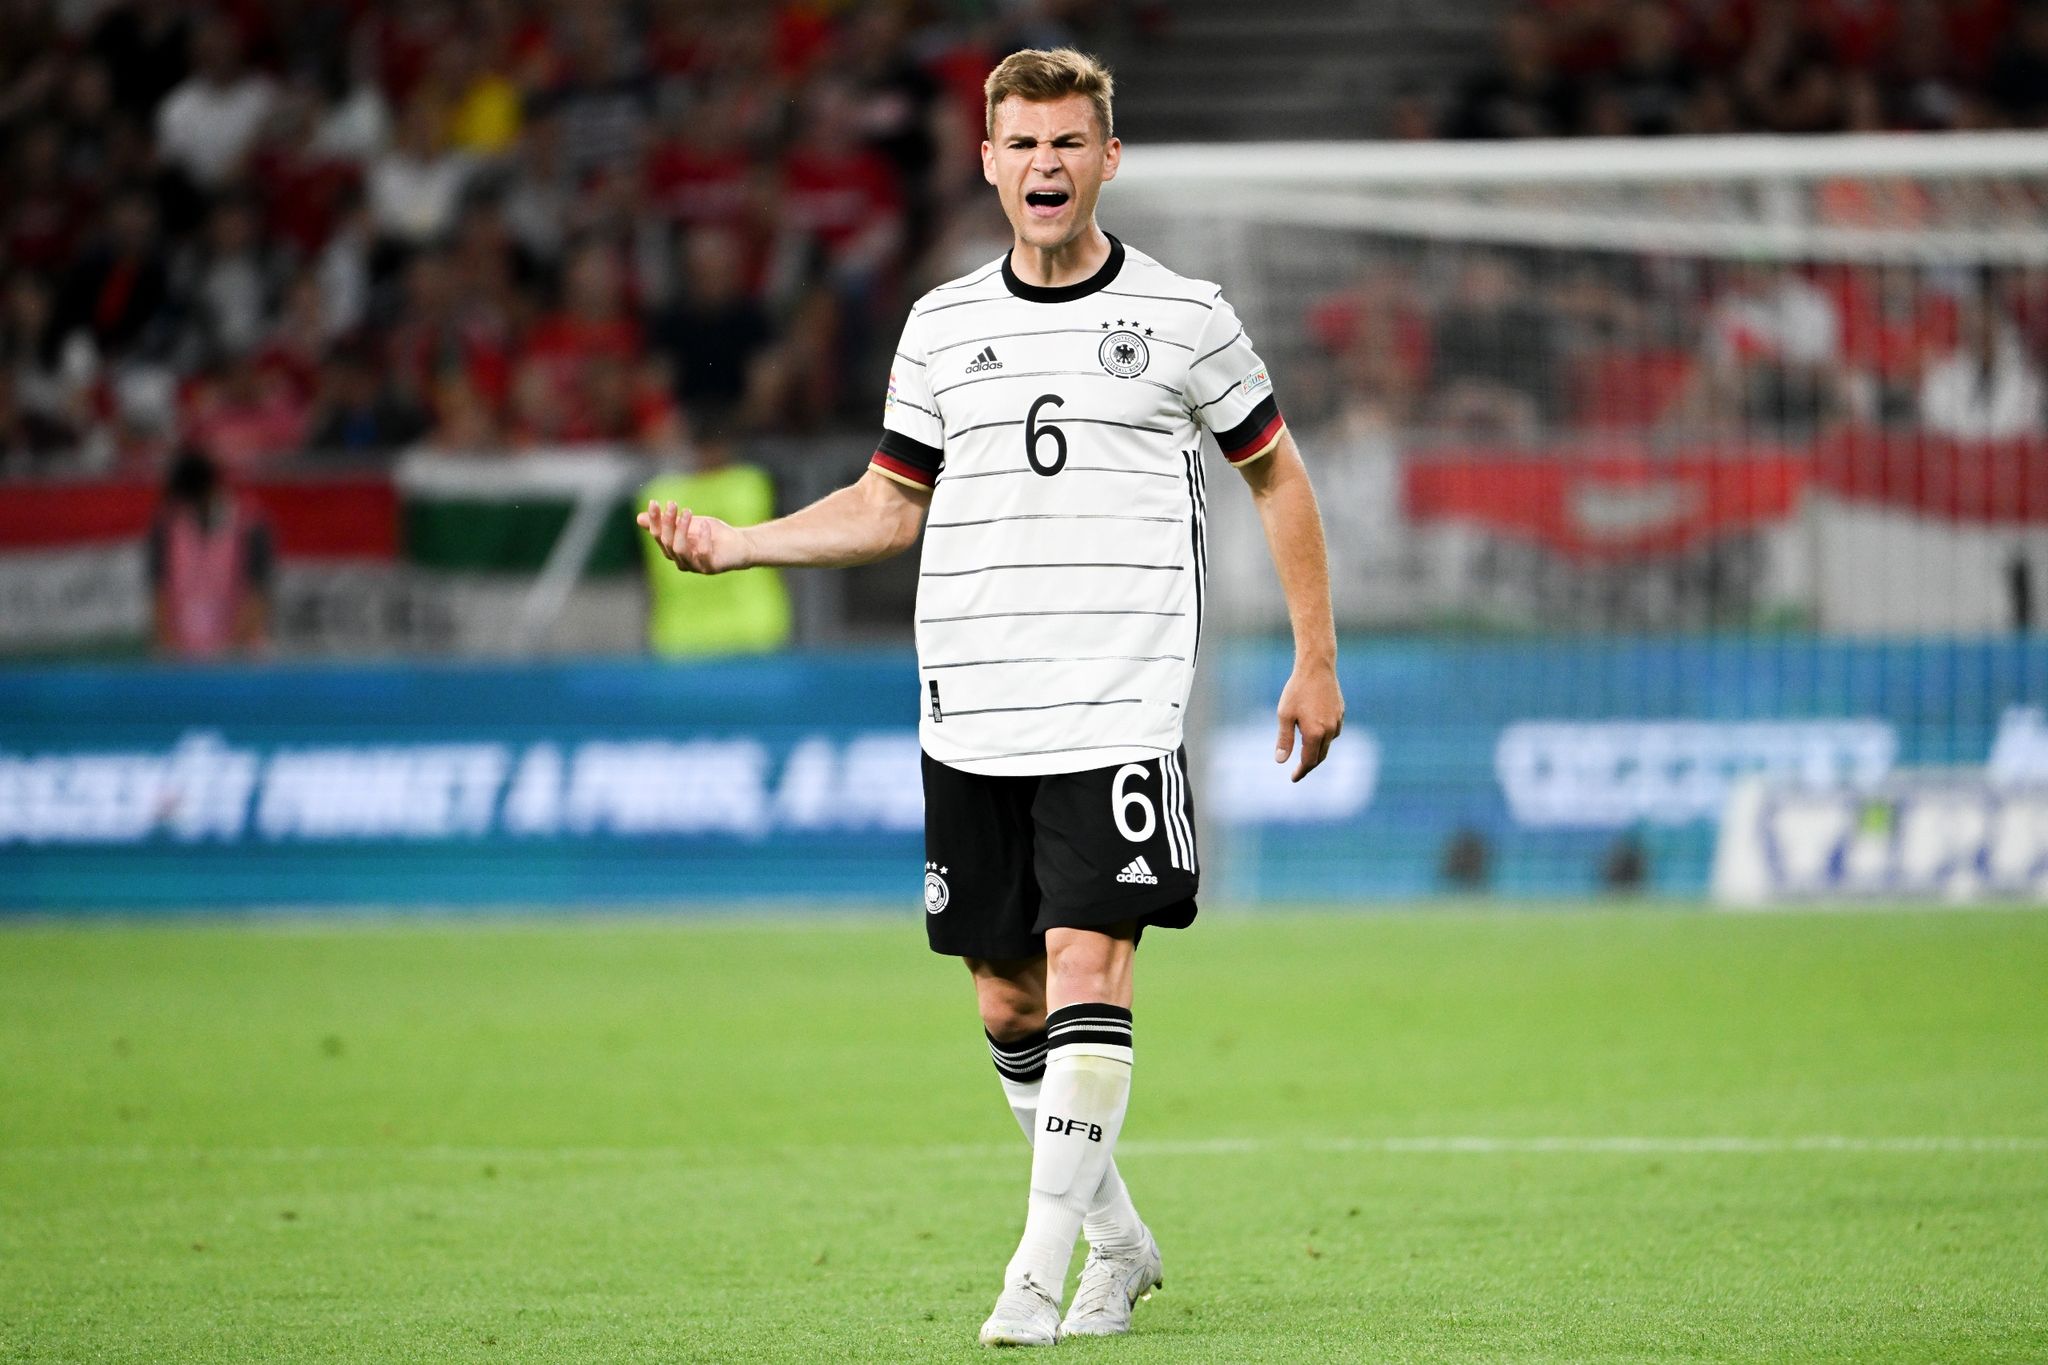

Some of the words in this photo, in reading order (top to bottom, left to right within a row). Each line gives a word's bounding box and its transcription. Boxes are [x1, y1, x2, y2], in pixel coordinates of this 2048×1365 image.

[965, 361, 1003, 374] adidas
[1025, 393, 1067, 477] 6
[1111, 763, 1156, 843] 6
[1116, 872, 1158, 885] adidas
[1045, 1115, 1103, 1142] DFB
